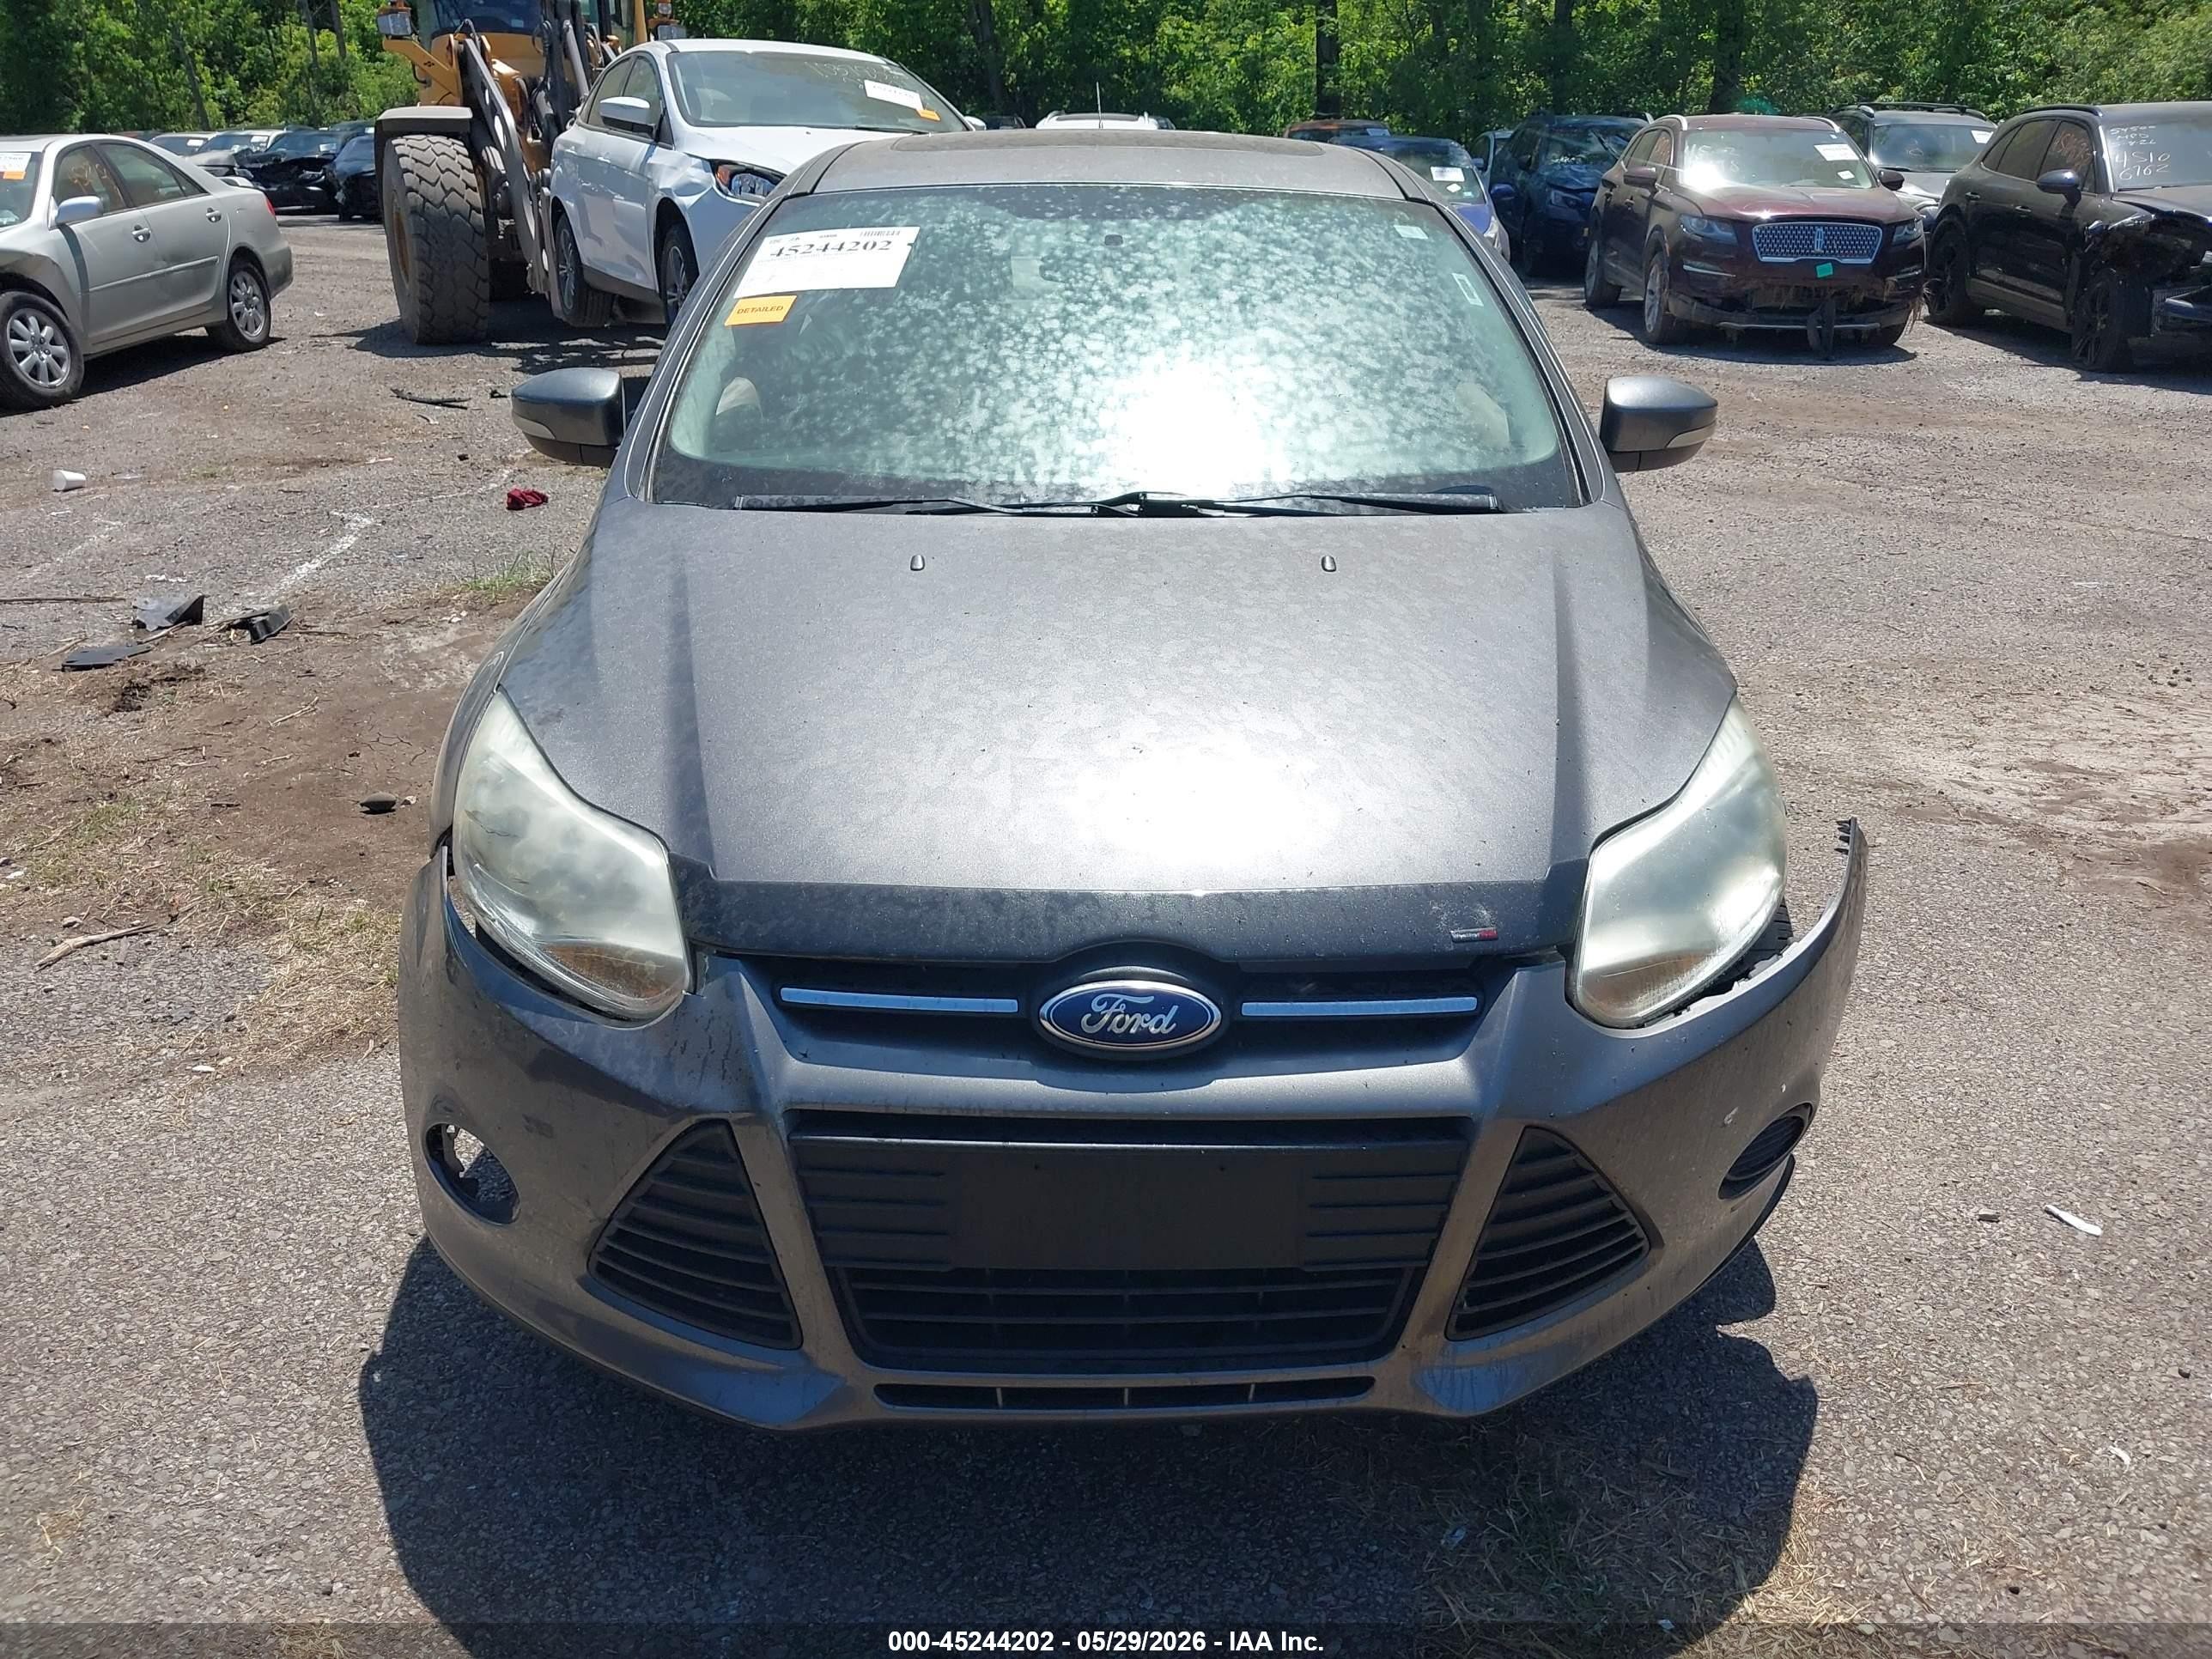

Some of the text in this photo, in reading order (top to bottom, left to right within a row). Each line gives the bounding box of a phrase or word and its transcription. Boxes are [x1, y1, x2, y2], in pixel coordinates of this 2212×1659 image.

[769, 240, 892, 258] 45244202
[737, 306, 784, 314] DETAILED
[1080, 994, 1178, 1034] Ford
